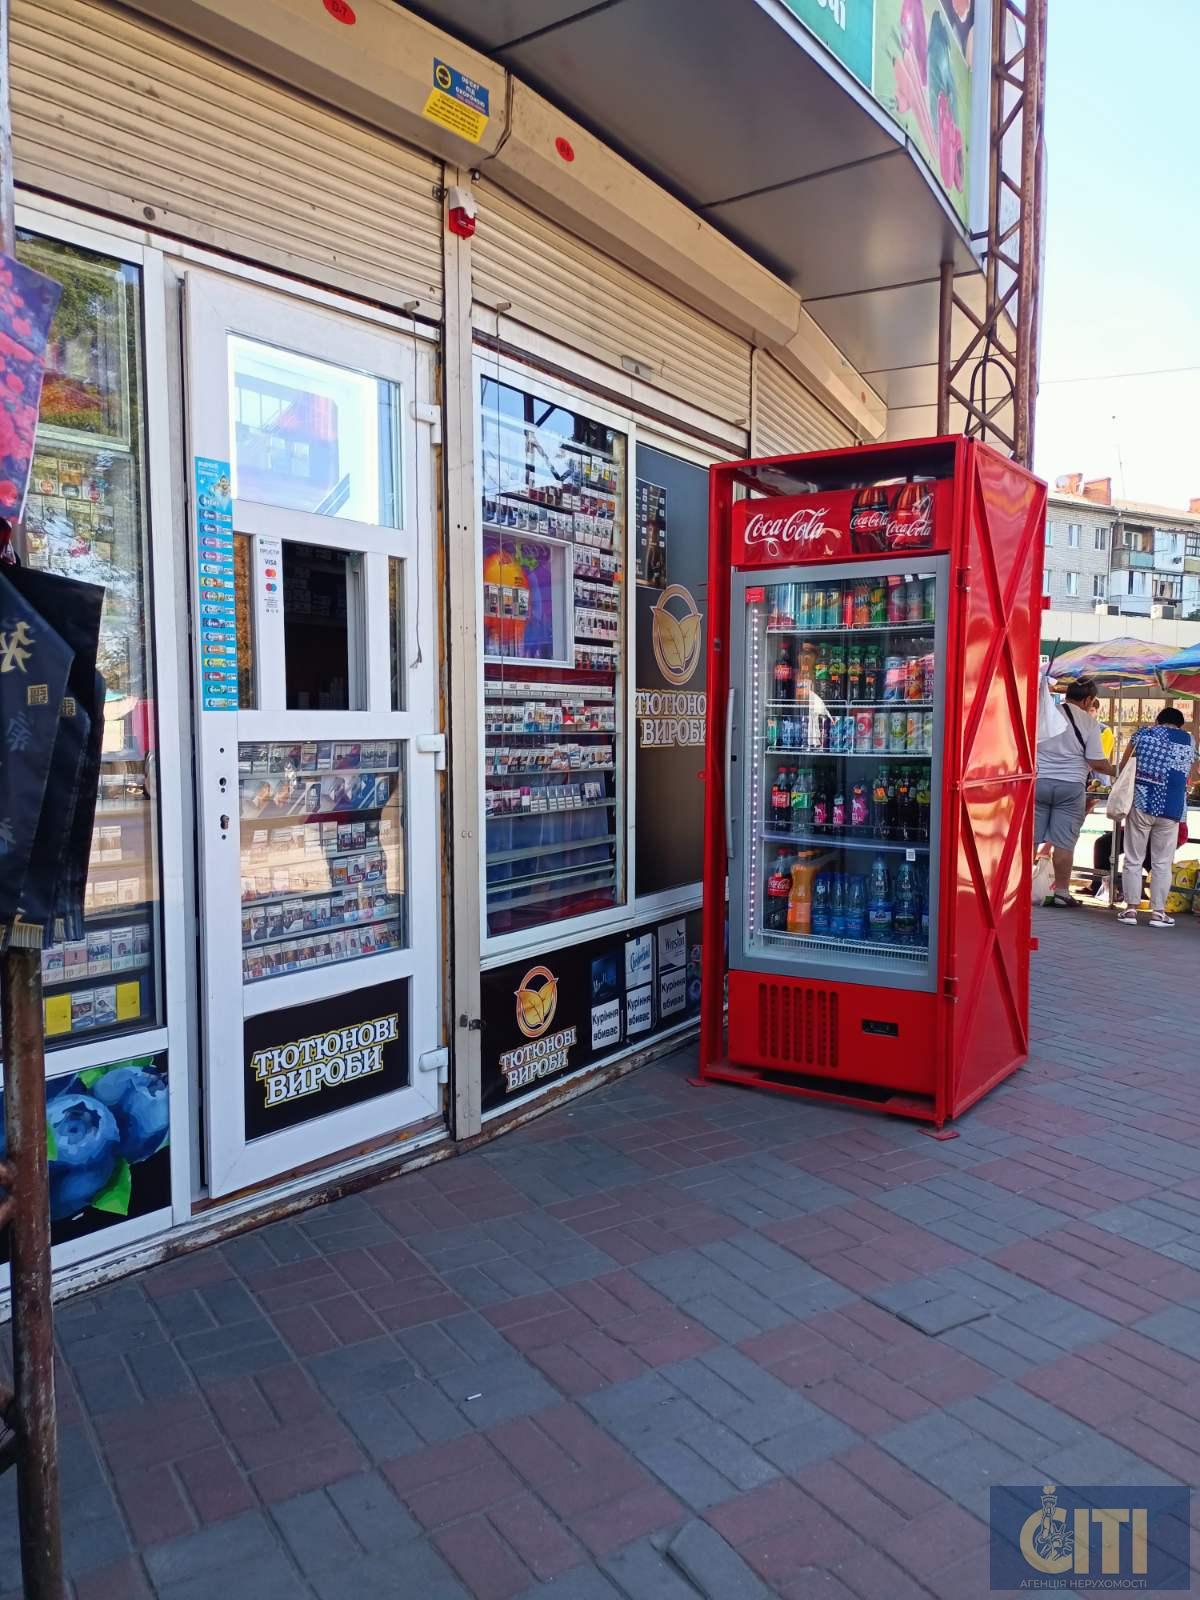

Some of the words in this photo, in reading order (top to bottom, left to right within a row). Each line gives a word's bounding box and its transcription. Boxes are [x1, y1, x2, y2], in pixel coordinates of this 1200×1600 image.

[636, 692, 706, 715] ТЮТЮНО
[661, 976, 686, 994] Куріння
[627, 995, 651, 1012] Куріння
[592, 1008, 619, 1026] Куріння
[628, 1012, 650, 1026] вбиває
[593, 1026, 618, 1041] вбиває
[255, 1017, 397, 1078] ТЮТЮНОВІ
[501, 1029, 577, 1071] ТЮТЮНОВІ
[266, 1046, 384, 1106] ВИРОБИ
[507, 1049, 569, 1090] ВИРОБИ
